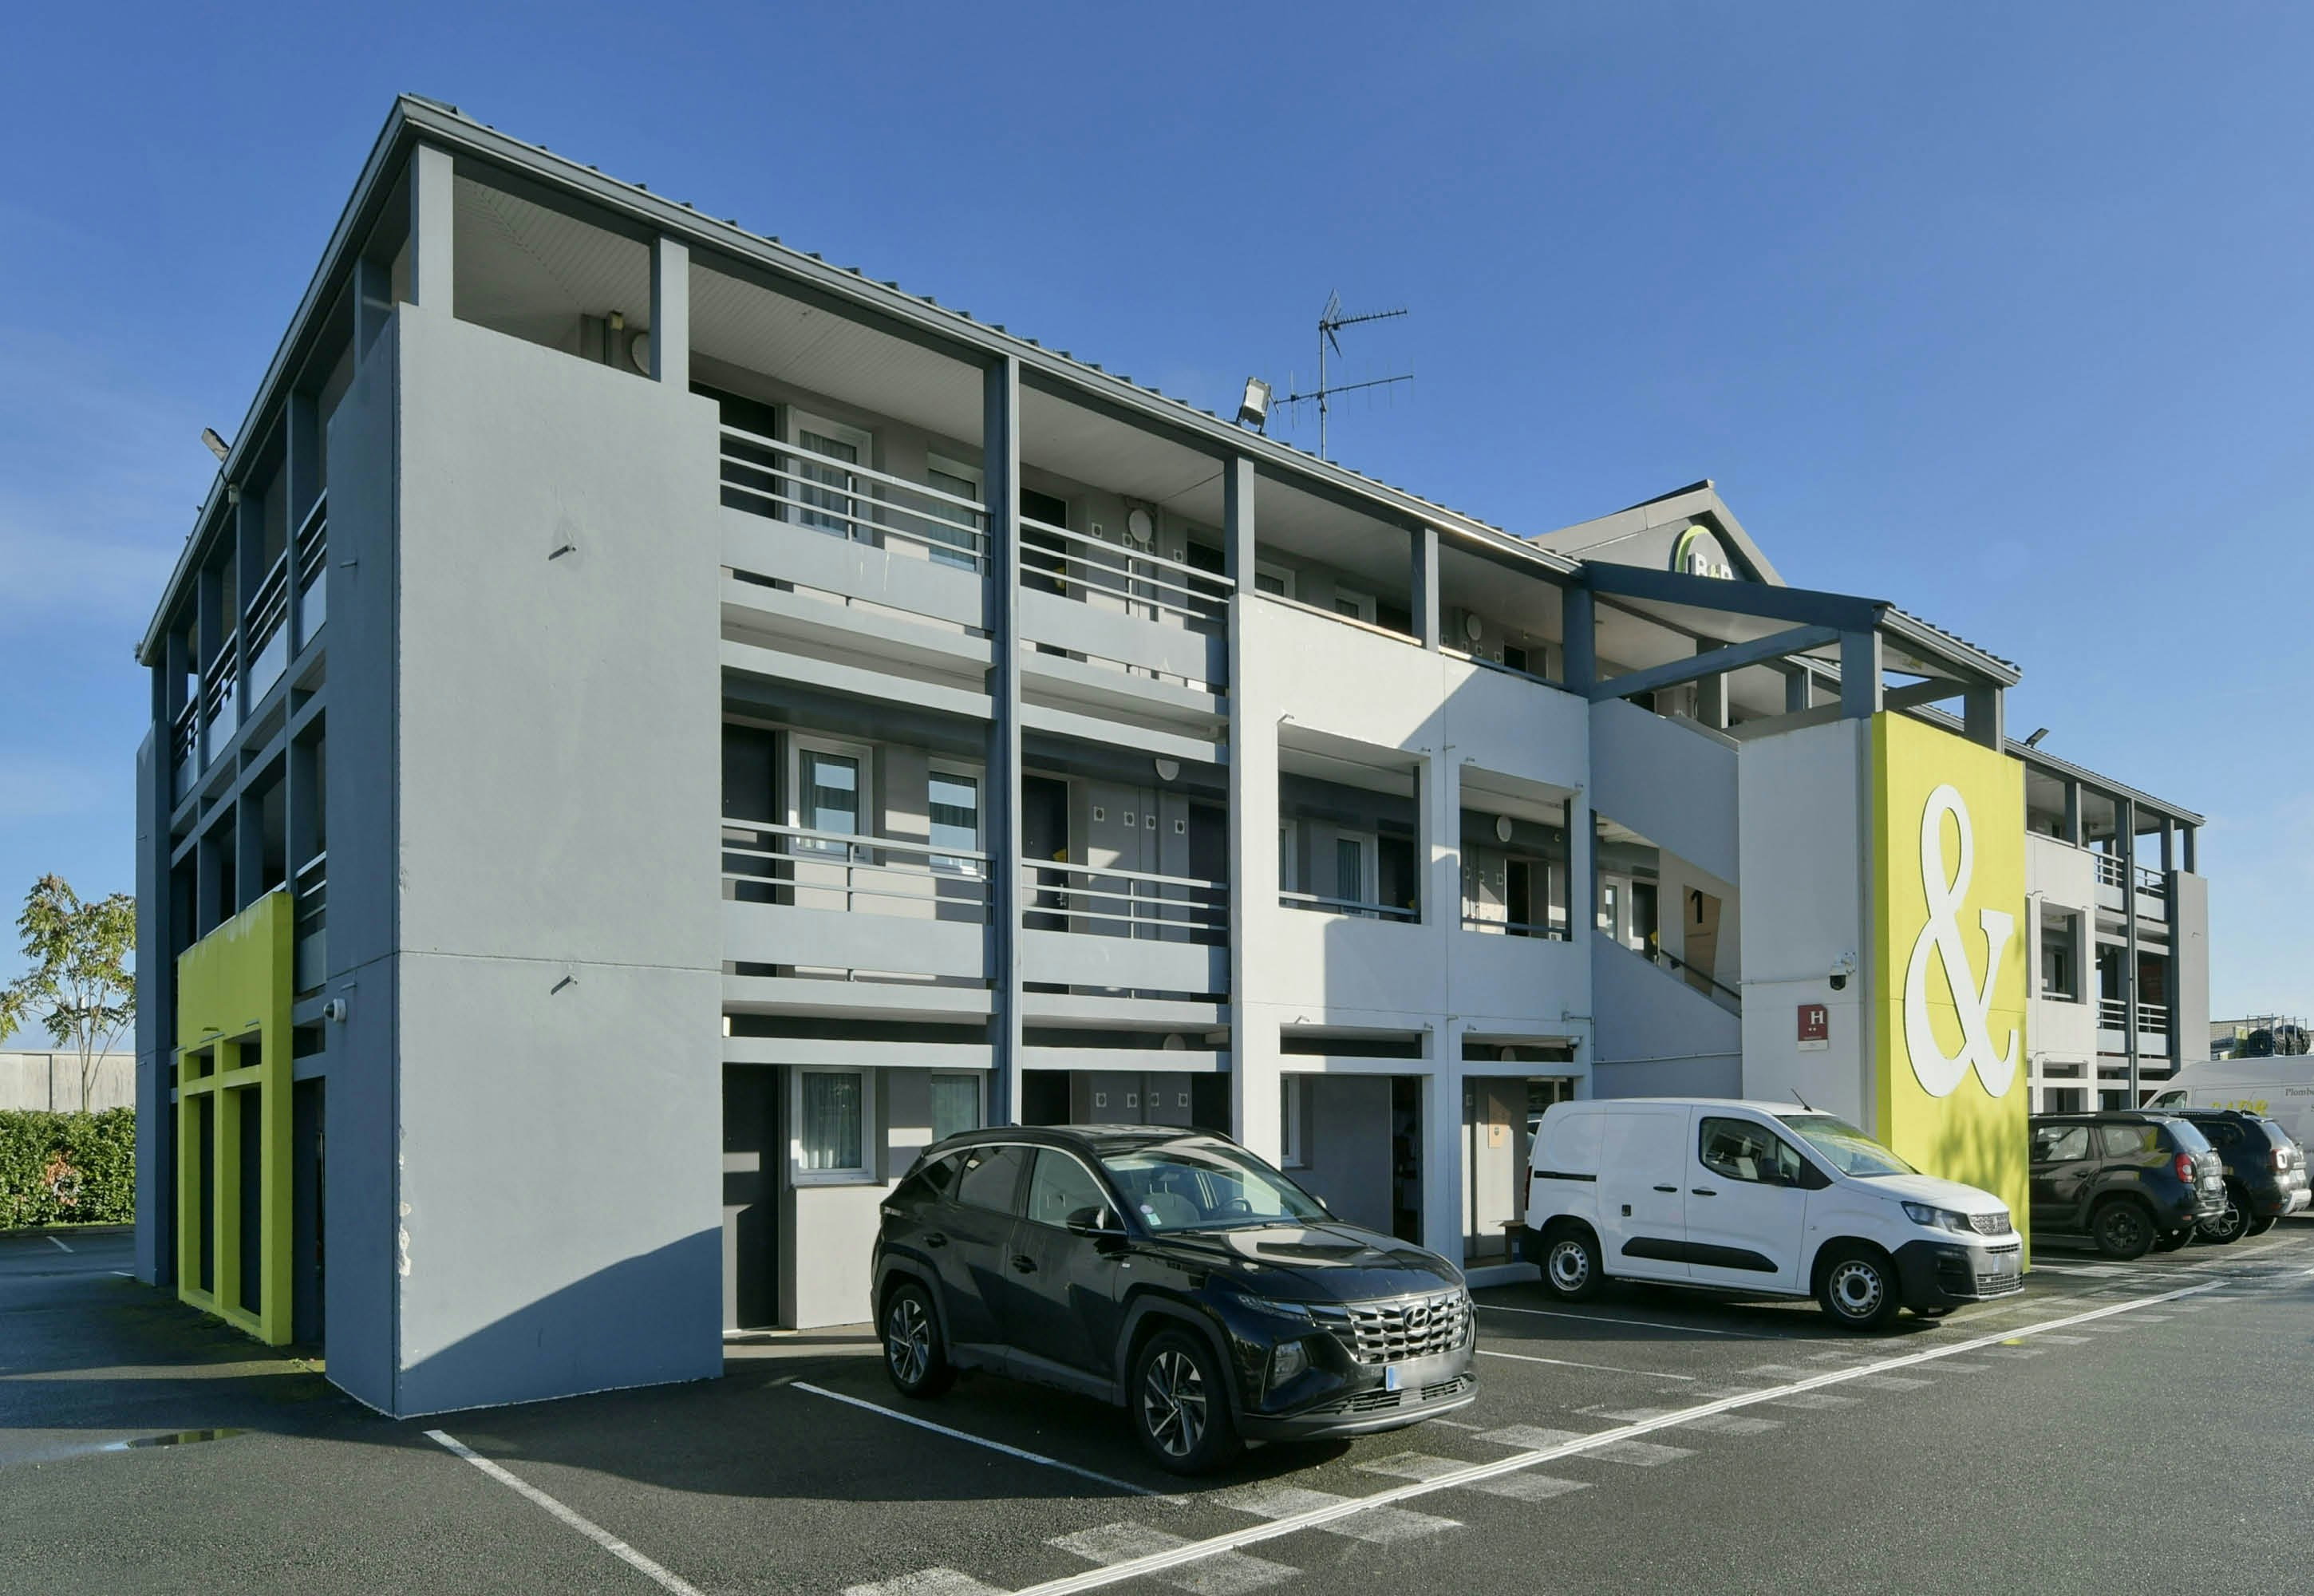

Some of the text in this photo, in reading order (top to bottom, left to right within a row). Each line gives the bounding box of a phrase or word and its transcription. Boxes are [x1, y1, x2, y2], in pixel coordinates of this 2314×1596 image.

[1690, 889, 1703, 923] 1
[1903, 784, 2019, 1097] &
[1811, 1010, 1824, 1024] H
